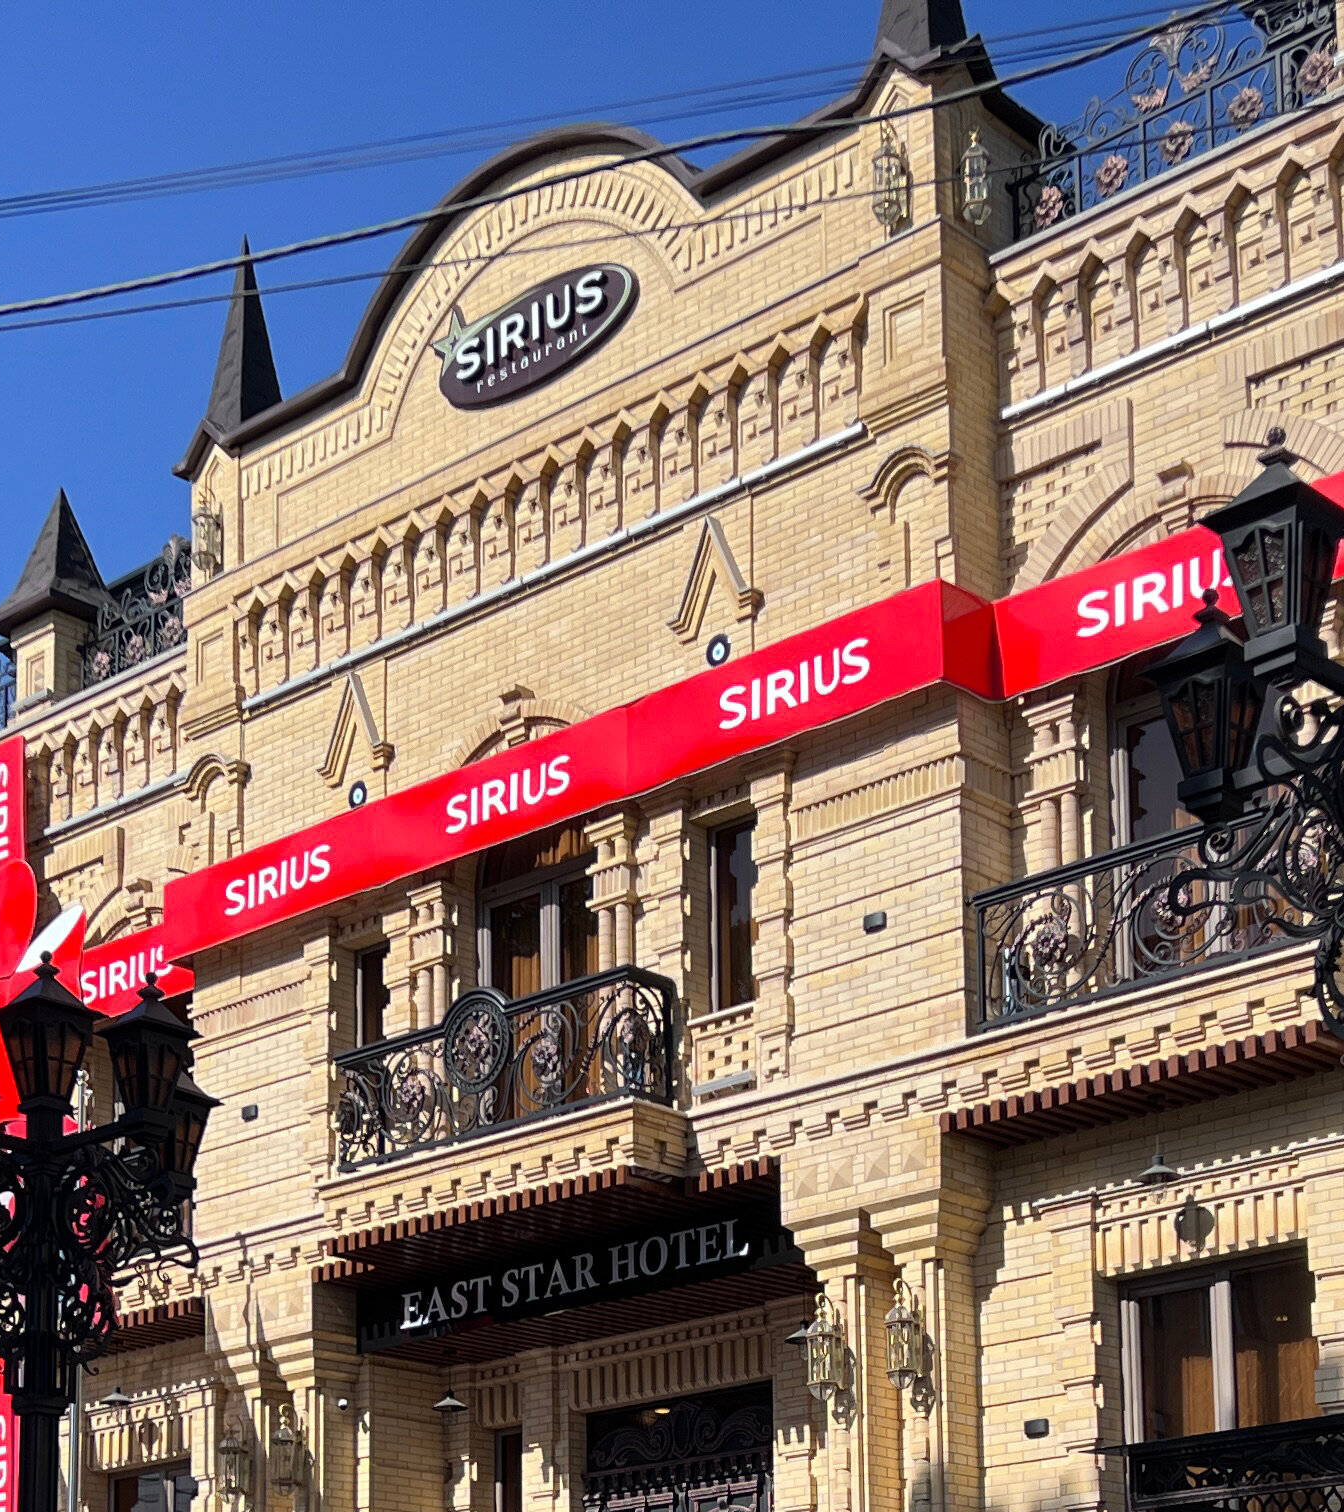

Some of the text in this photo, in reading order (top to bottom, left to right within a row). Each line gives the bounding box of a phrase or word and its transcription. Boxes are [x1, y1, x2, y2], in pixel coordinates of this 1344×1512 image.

[455, 270, 604, 380] SIRIUS
[476, 322, 589, 394] restaurant
[1076, 548, 1234, 638] SIRIU
[717, 638, 870, 730] SIRIUS
[444, 755, 571, 835] SIRIUS
[224, 844, 331, 916] SIRIUS
[399, 1218, 750, 1331] EAST STAR HOTEL
